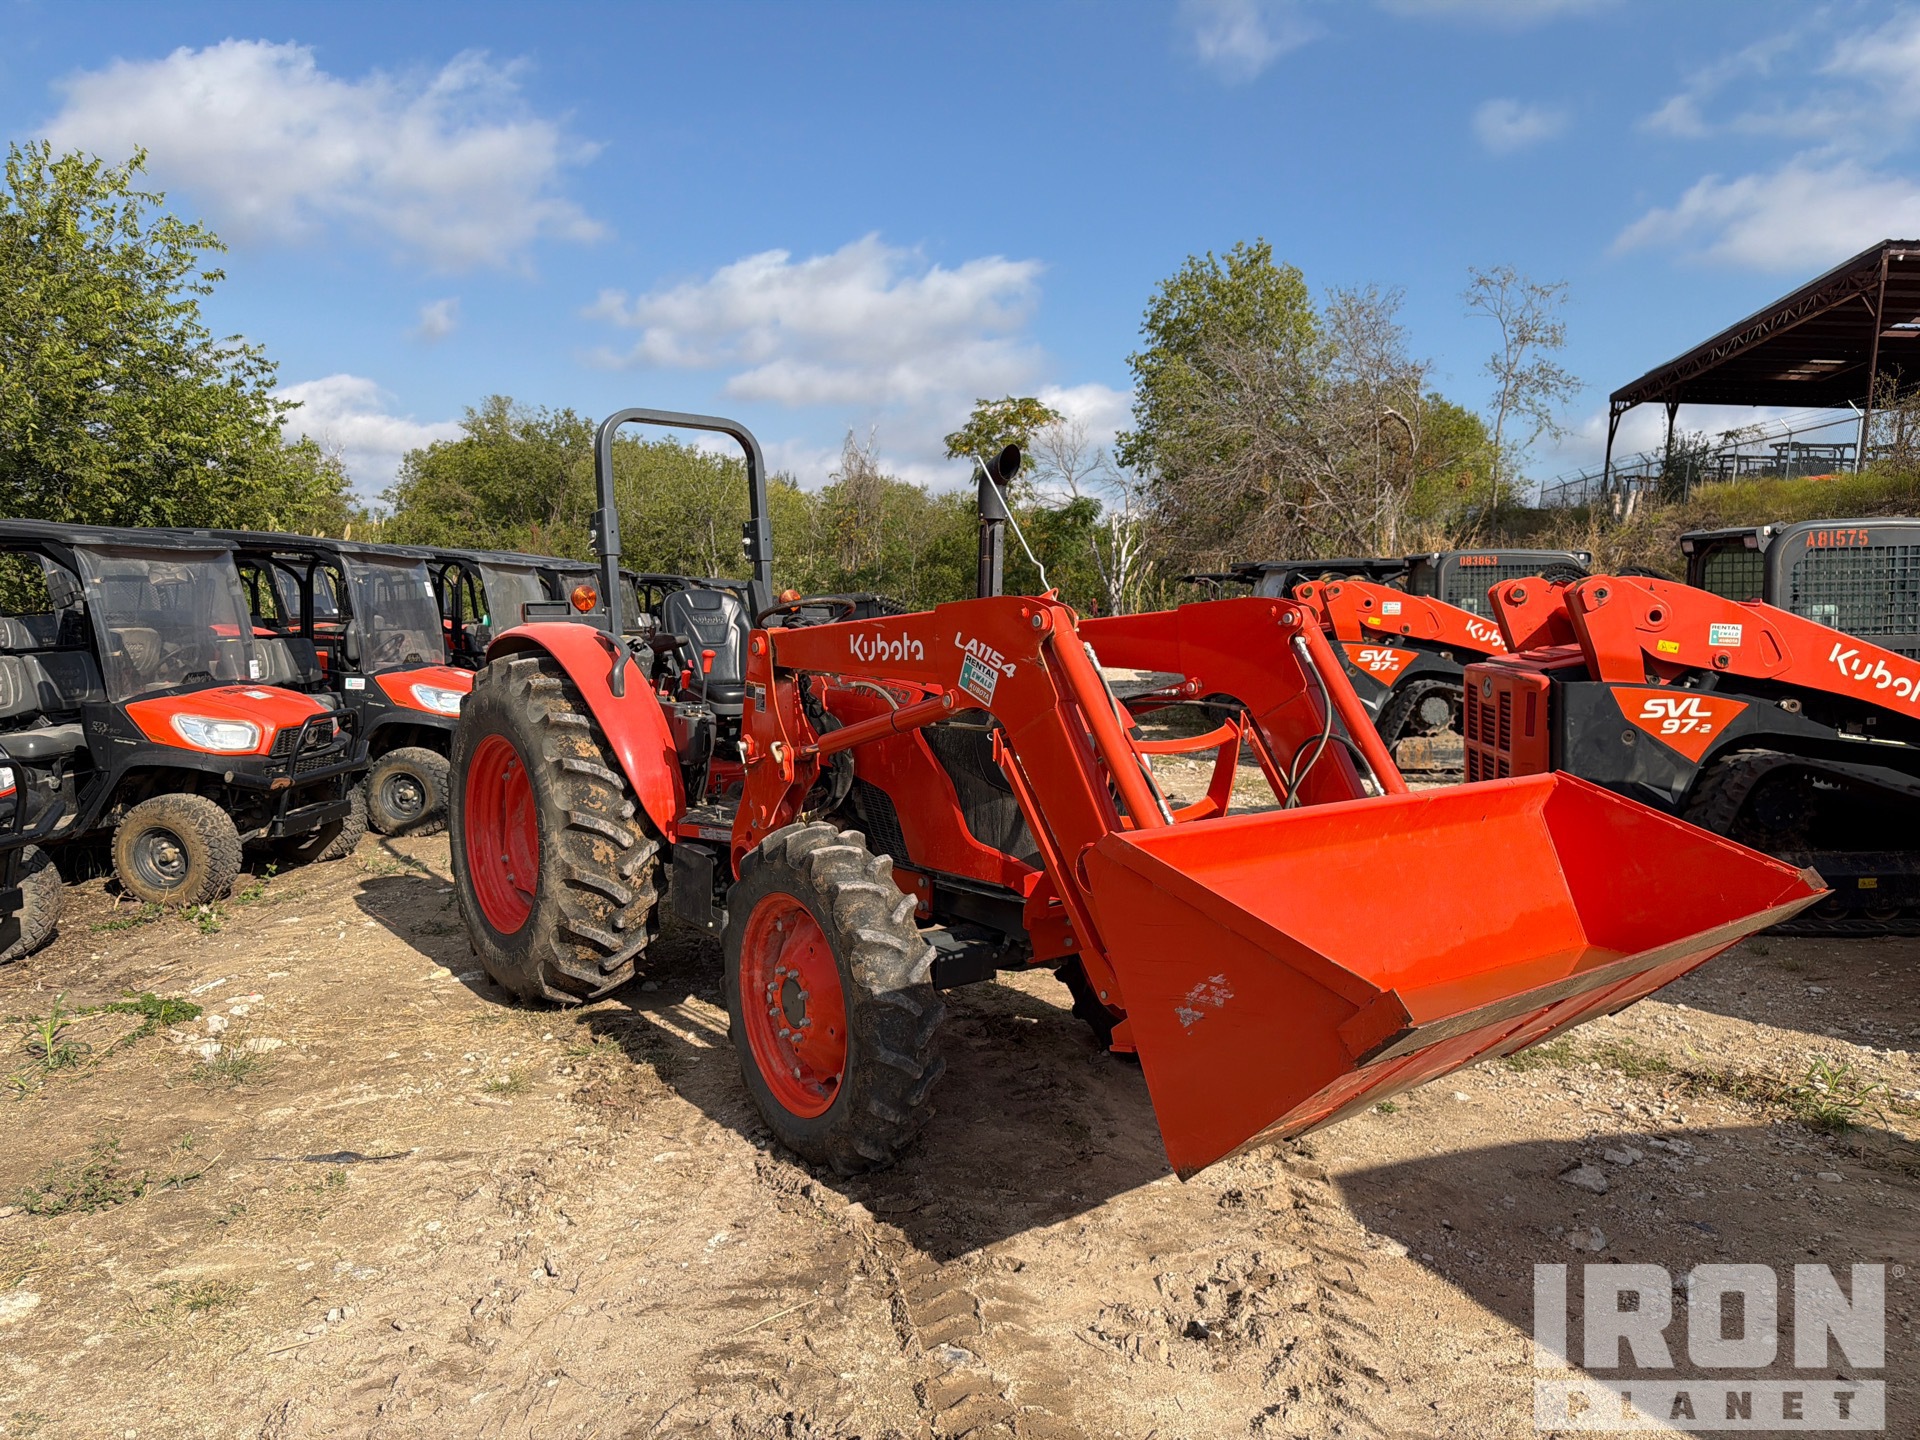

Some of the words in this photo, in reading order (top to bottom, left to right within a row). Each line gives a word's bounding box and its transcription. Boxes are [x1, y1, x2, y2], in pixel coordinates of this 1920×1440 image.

[1806, 529, 1868, 547] A81575
[849, 631, 924, 661] Kubota
[954, 631, 1017, 678] LA1154
[1357, 650, 1399, 662] SVL
[966, 655, 995, 680] RENTAL
[971, 671, 993, 690] EWALD
[968, 683, 989, 700] KUBOTA
[1639, 698, 1712, 719] SVL
[1660, 718, 1712, 734] 97-2
